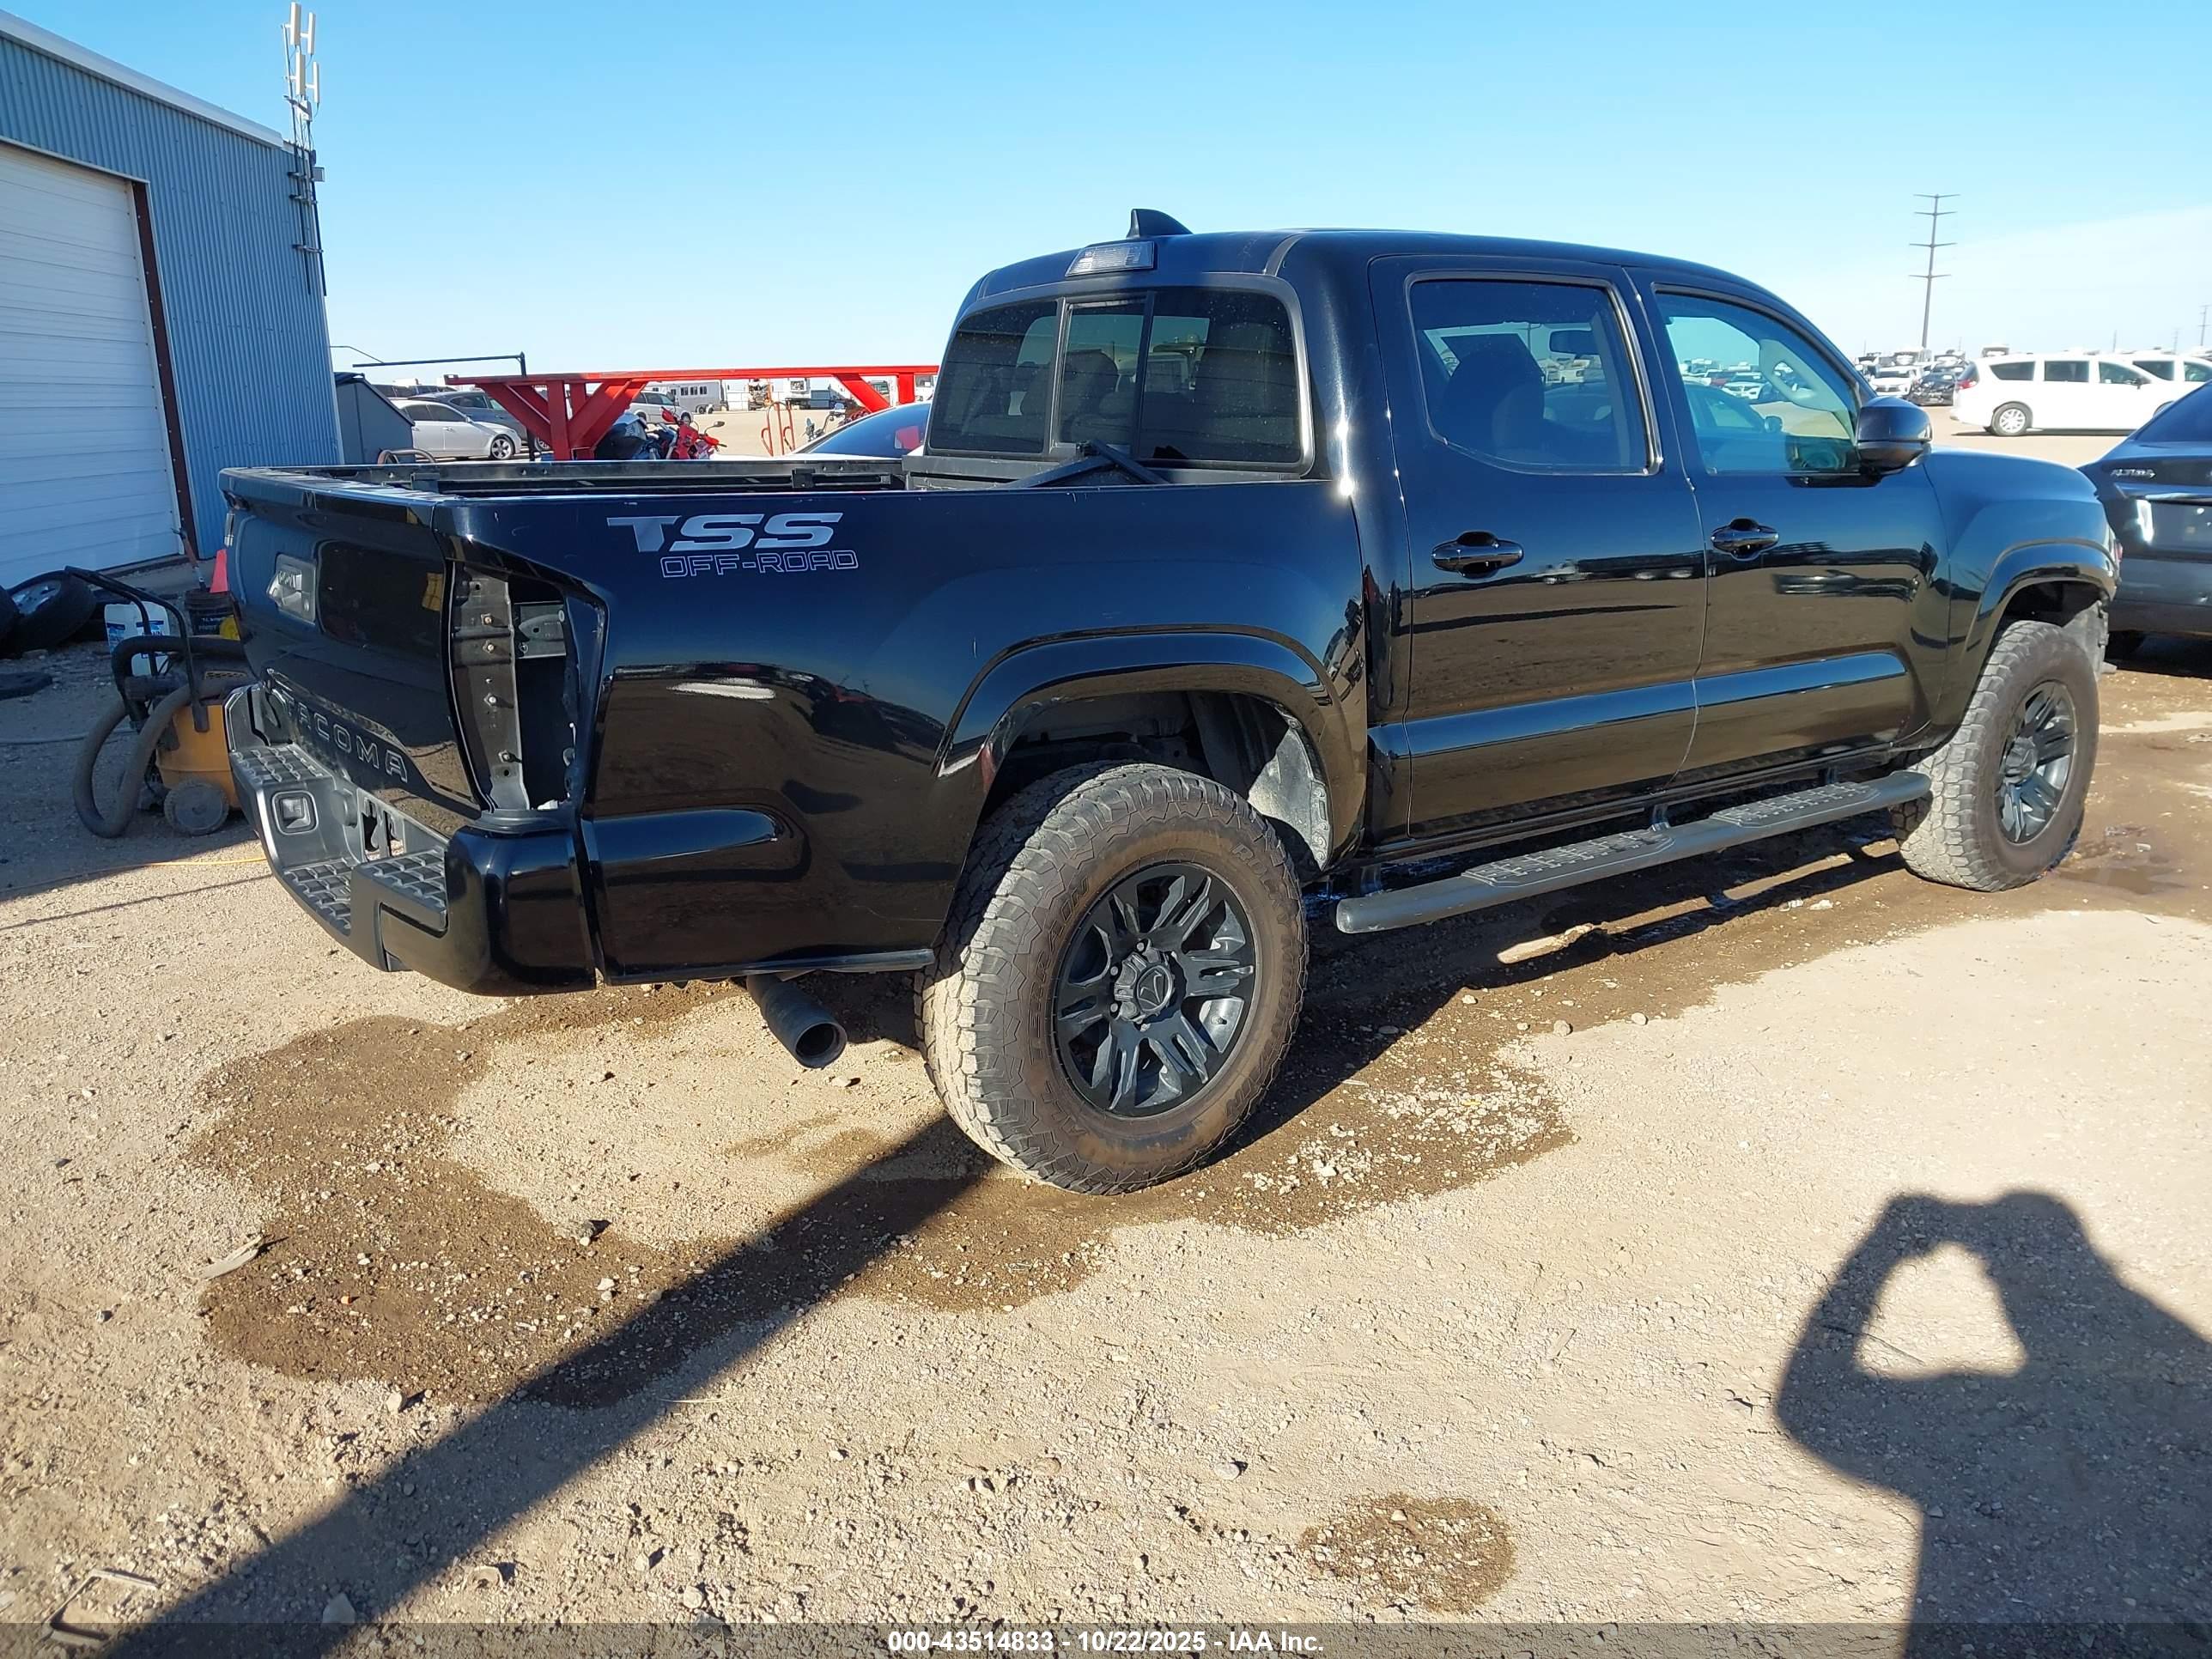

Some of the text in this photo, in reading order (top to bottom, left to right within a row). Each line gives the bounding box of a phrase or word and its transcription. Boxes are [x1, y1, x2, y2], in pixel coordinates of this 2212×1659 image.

[606, 513, 843, 552] TSS
[660, 550, 859, 578] OFF-ROAD
[282, 690, 408, 783] TACOMA
